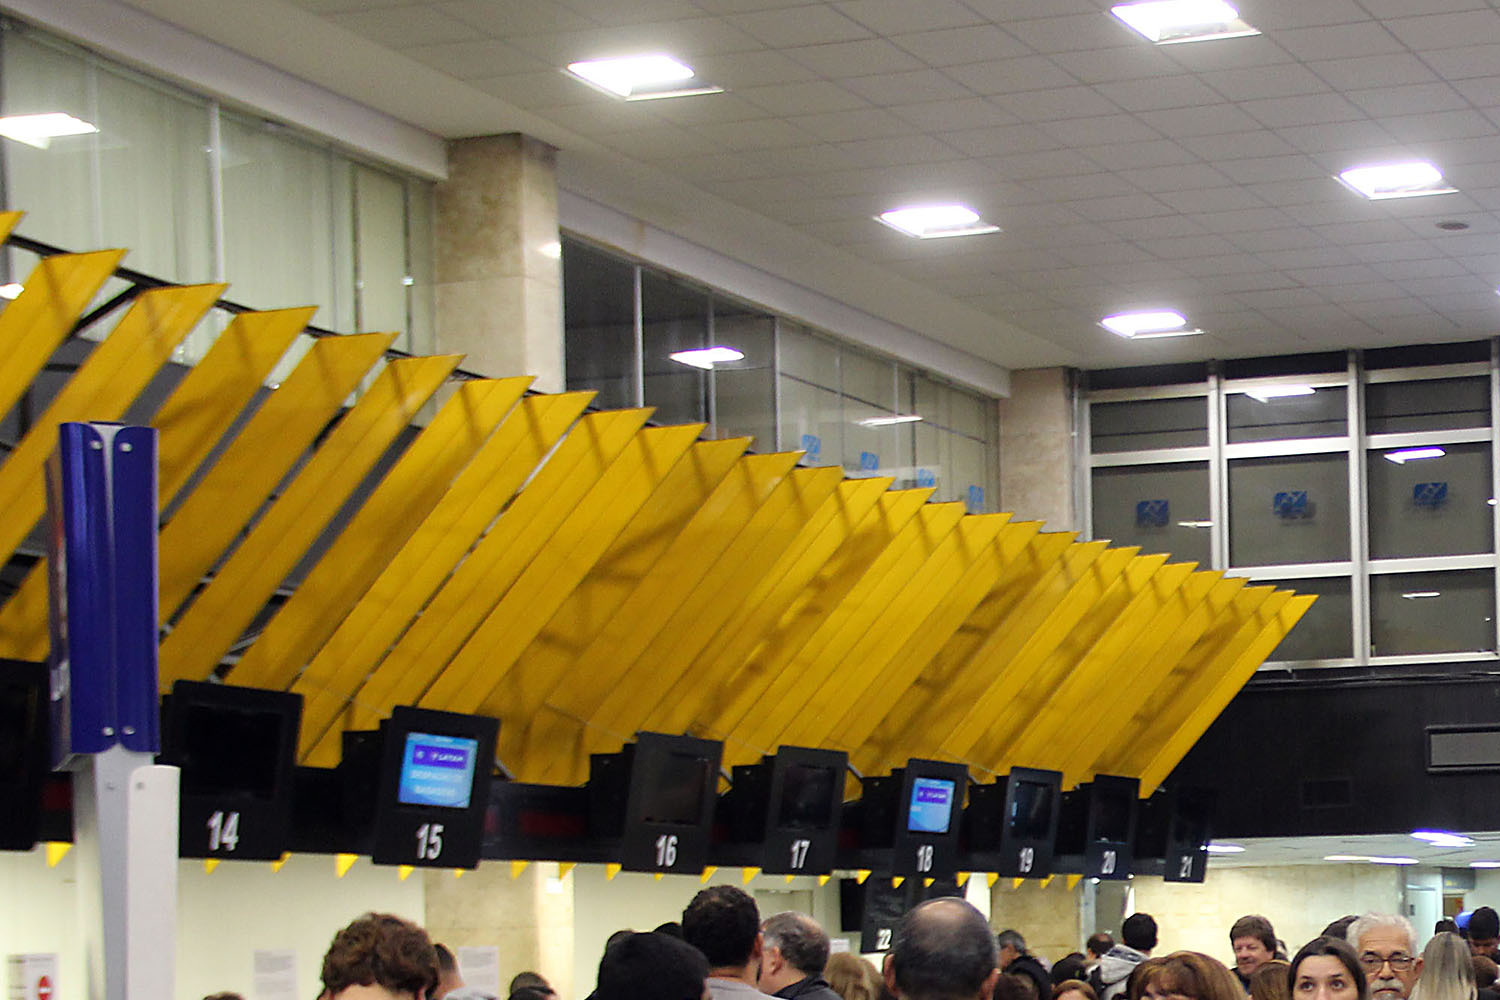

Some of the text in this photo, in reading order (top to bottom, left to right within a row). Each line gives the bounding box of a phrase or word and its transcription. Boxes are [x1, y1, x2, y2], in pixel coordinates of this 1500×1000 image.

[207, 810, 240, 851] 14
[416, 823, 444, 860] 15
[656, 834, 679, 867] 16
[791, 839, 811, 869] 17
[917, 844, 934, 873] 18
[1019, 847, 1034, 873] 19
[1101, 850, 1117, 875] 20
[1179, 855, 1193, 878] 21
[876, 928, 892, 950] 22
